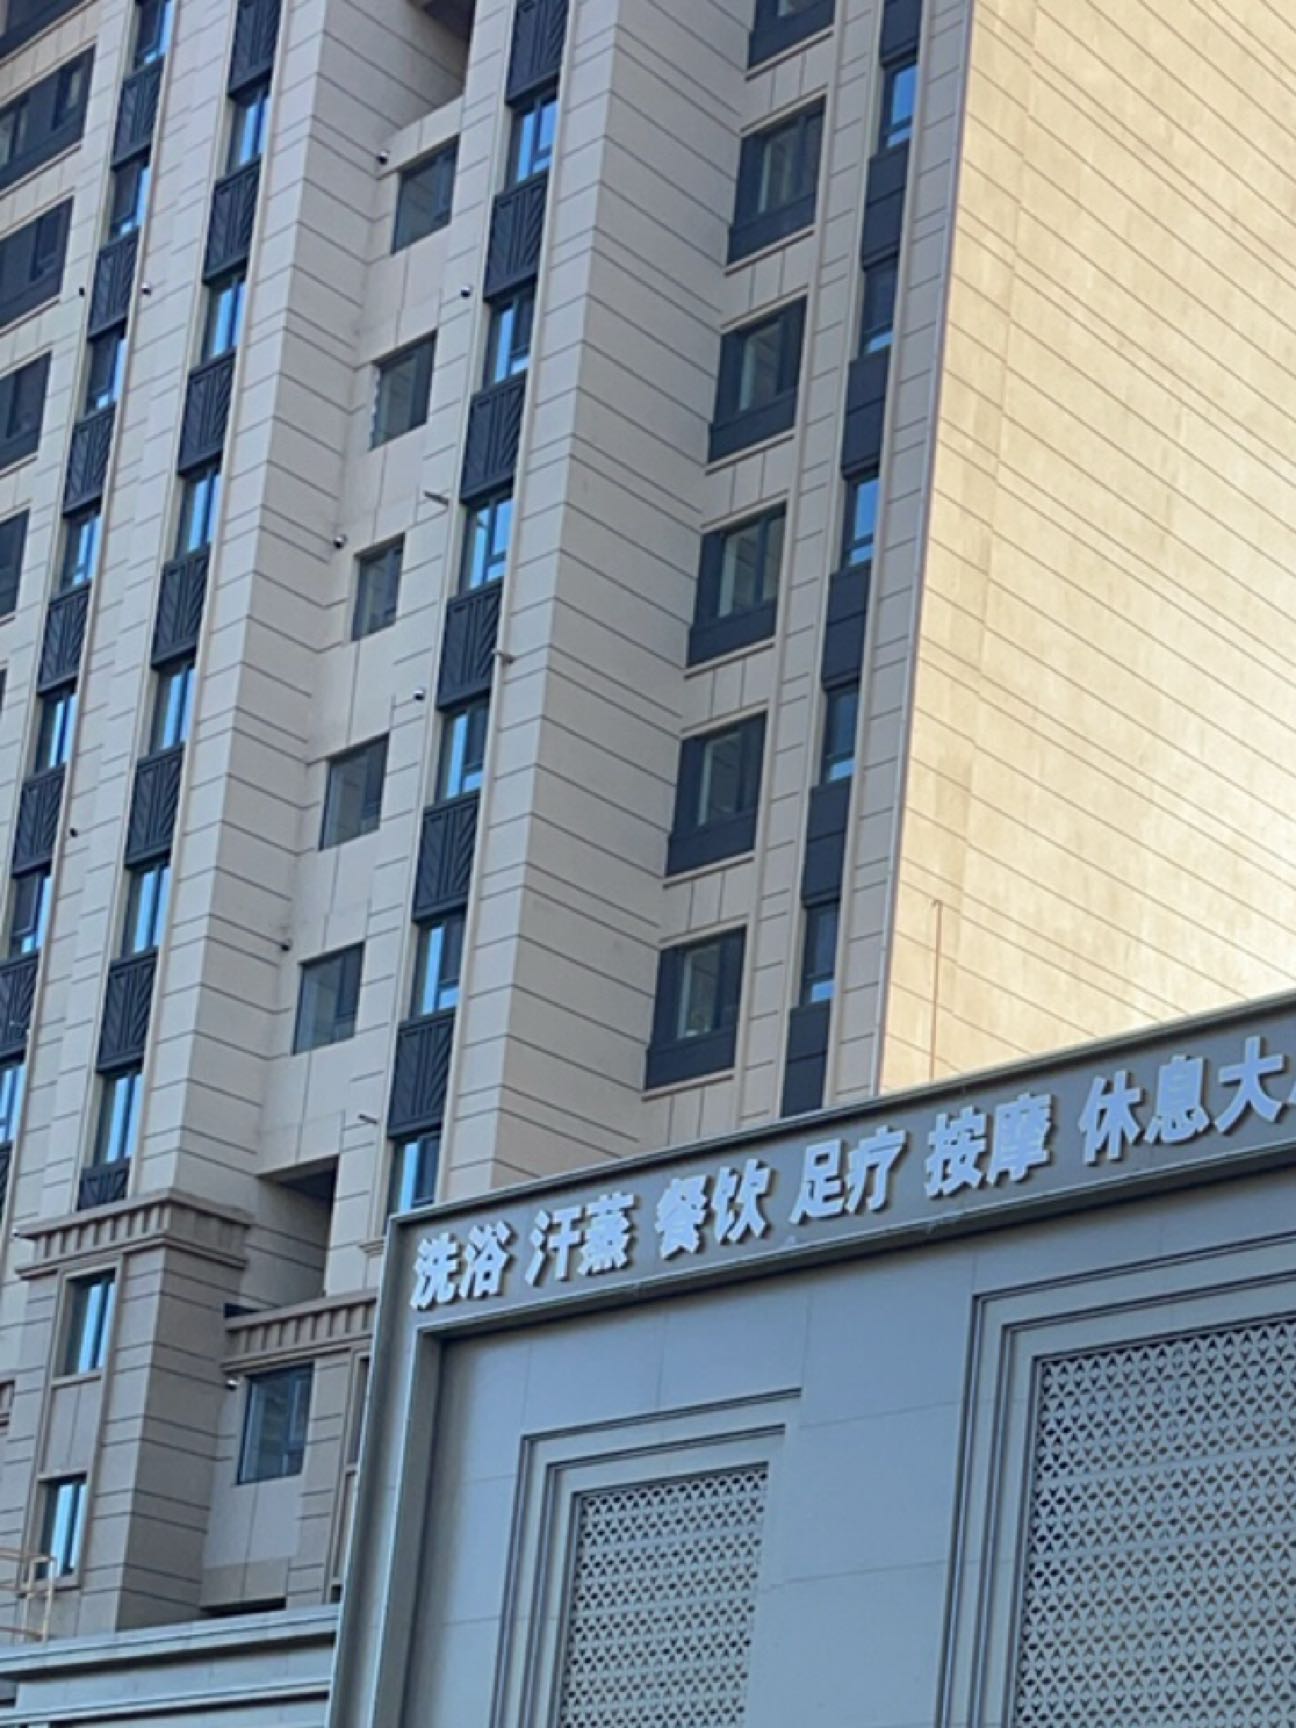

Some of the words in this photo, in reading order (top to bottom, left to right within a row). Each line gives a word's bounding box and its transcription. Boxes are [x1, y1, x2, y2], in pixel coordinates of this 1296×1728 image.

[413, 1221, 513, 1310] 洗浴
[525, 1191, 637, 1286] 汗蒸
[653, 1157, 774, 1260] 餐饮
[790, 1125, 908, 1224] 足疗
[924, 1092, 1054, 1198] 按摩
